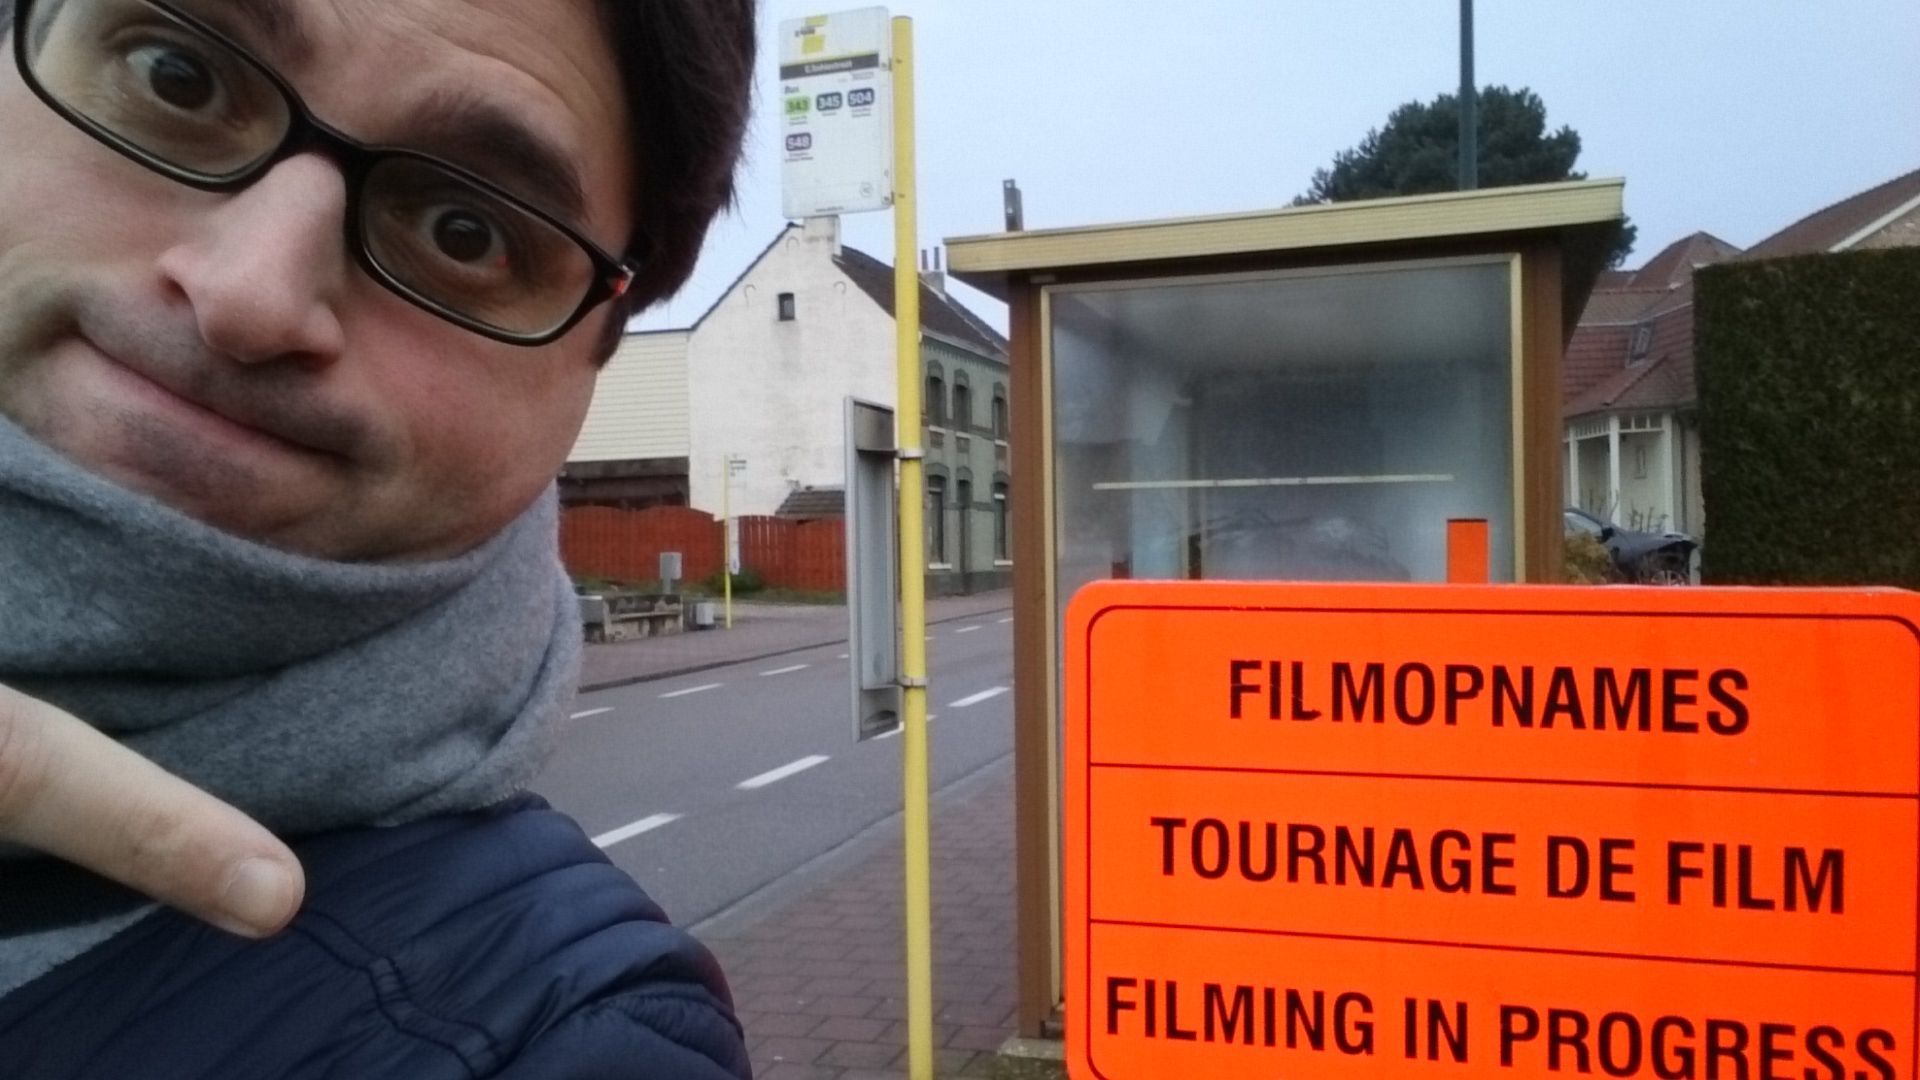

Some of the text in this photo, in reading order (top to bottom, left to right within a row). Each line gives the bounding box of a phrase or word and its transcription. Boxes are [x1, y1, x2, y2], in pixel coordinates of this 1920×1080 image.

[818, 95, 840, 109] 345
[849, 90, 873, 106] 504
[787, 135, 810, 150] 548
[1230, 660, 1749, 736] FILMOPNAMES
[1150, 817, 1844, 913] TOURNAGE DE FILM
[1107, 977, 1897, 1080] FILMING IN PROGRESS
